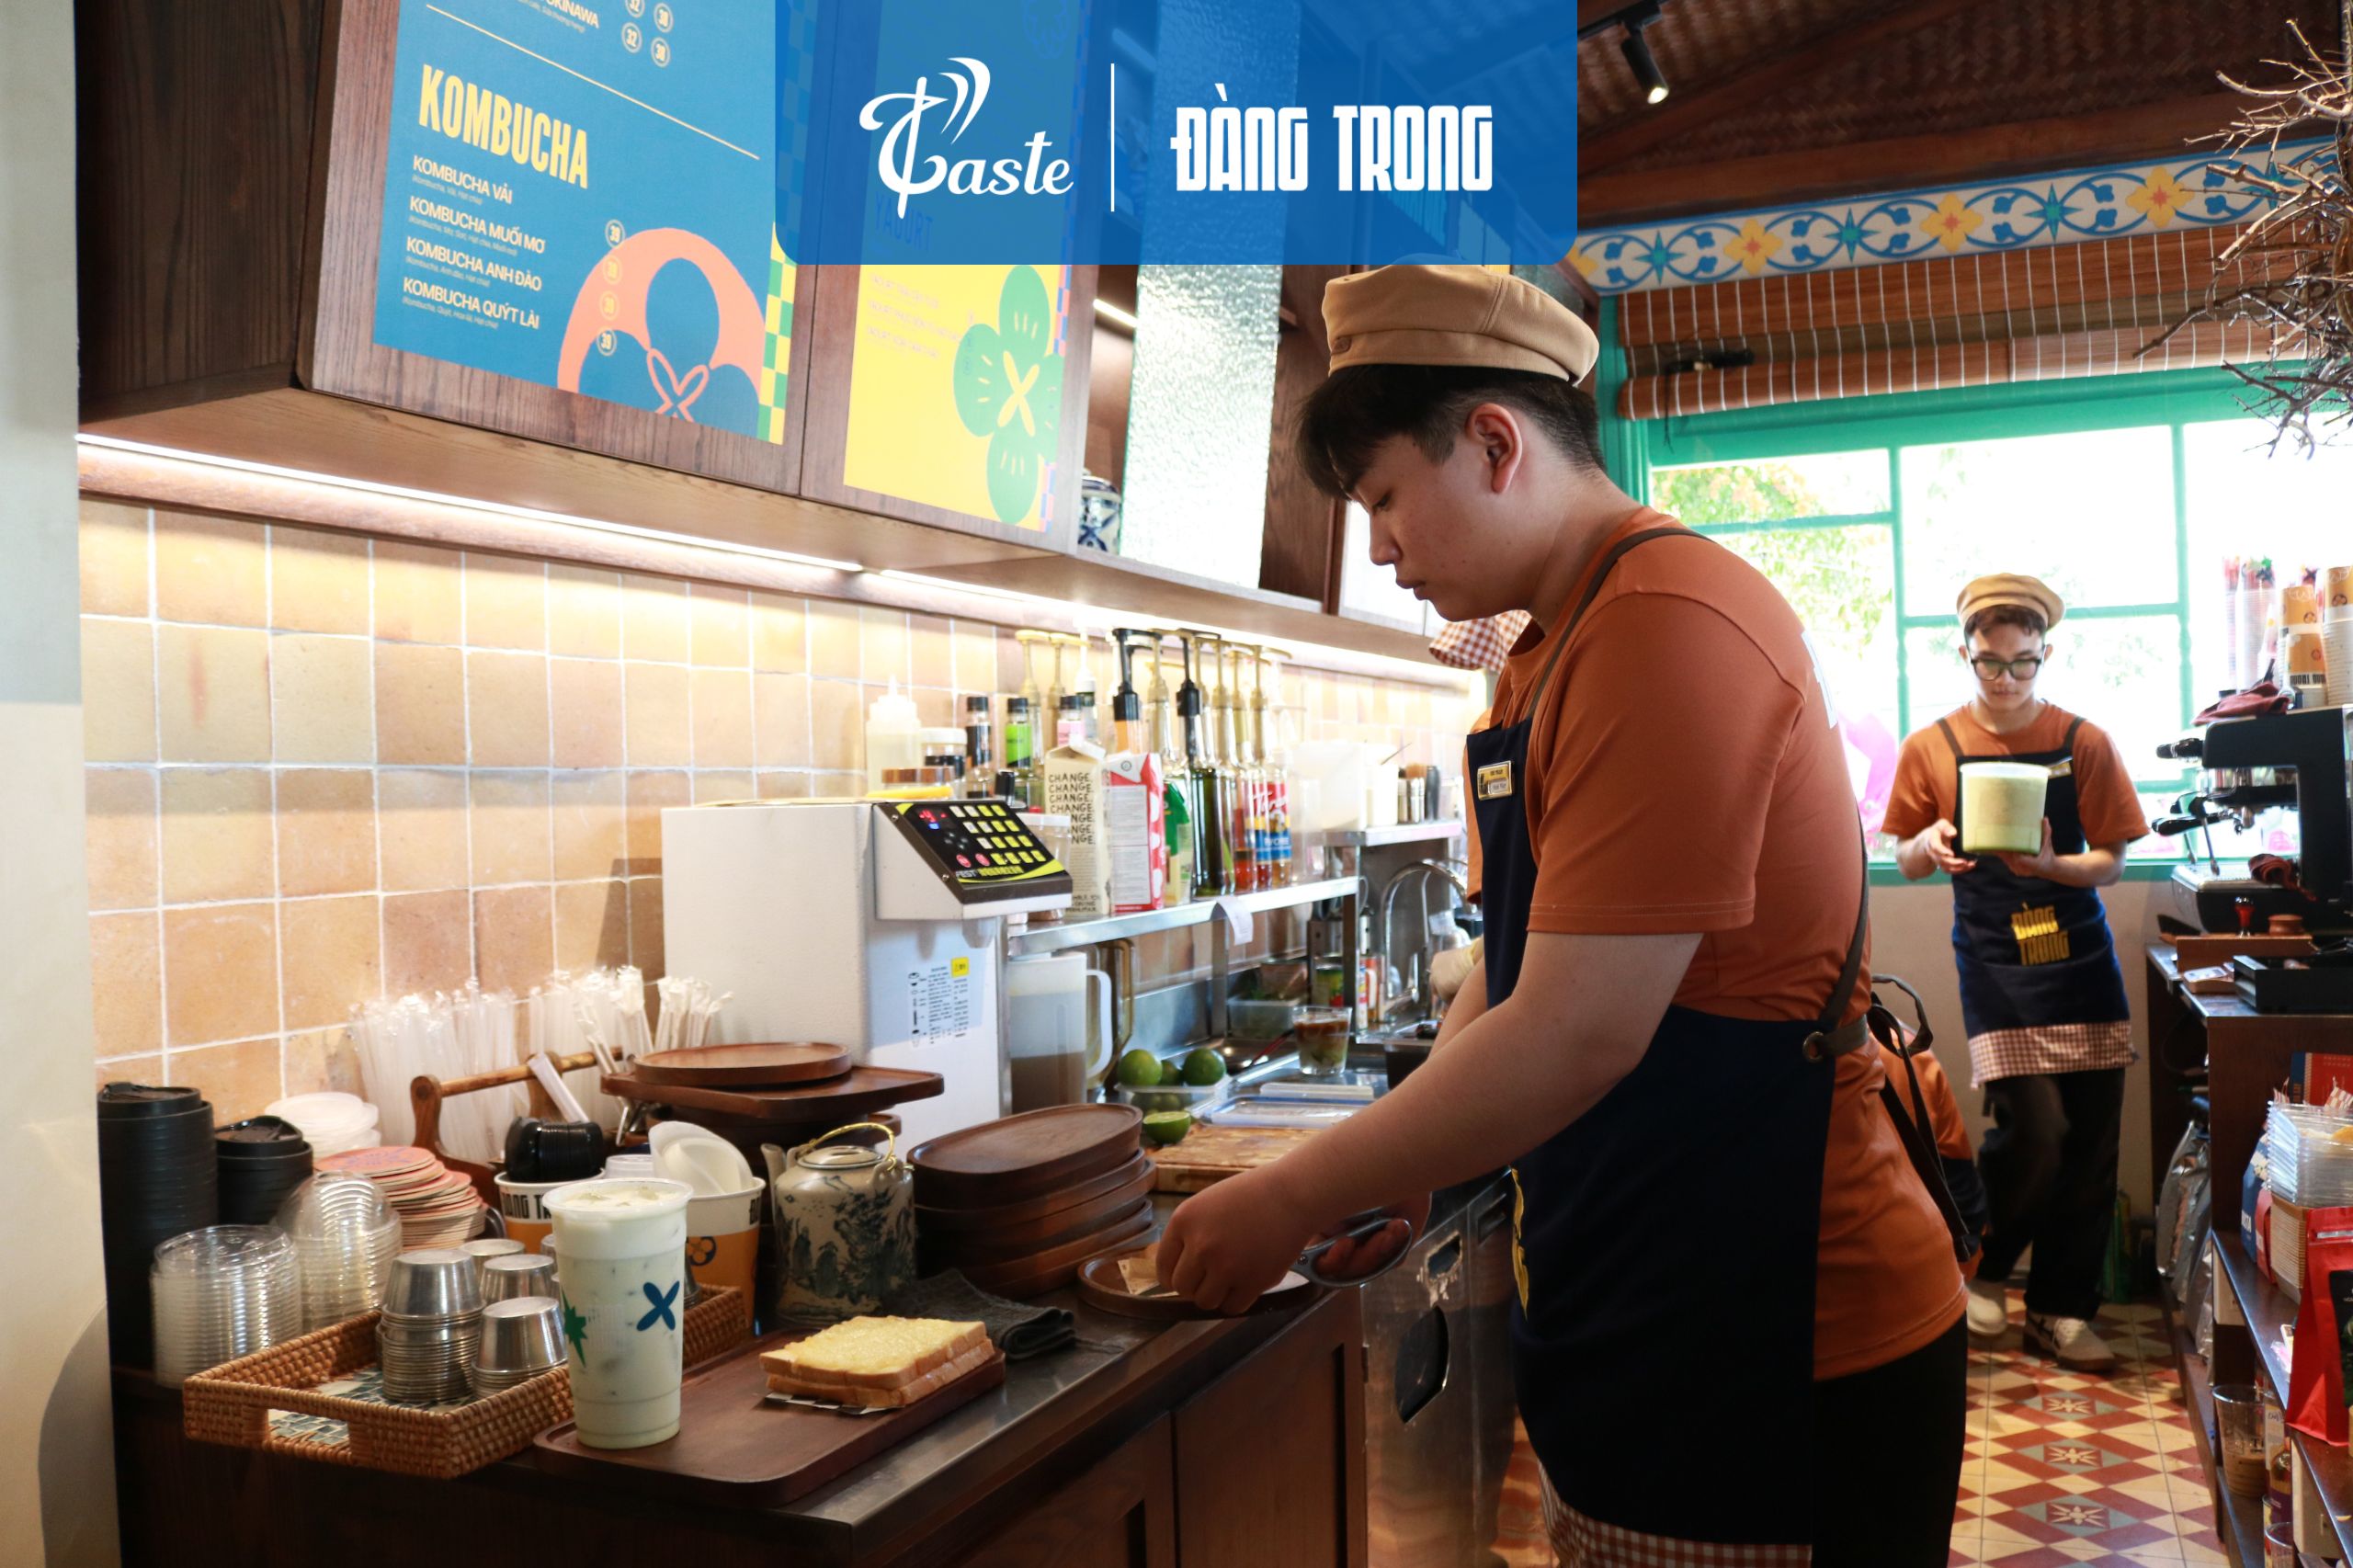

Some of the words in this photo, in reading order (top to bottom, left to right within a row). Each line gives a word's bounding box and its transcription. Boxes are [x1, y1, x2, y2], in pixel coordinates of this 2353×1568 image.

[419, 64, 587, 188] KOMBUCHA
[414, 155, 490, 197] KOMBUCHA
[410, 196, 486, 235] KOMBUCHA
[489, 222, 522, 246] MUỐI
[524, 235, 545, 254] MƠ
[406, 236, 483, 274] KOMBUCHA
[485, 262, 513, 283] ANH
[515, 269, 542, 291] ĐÀO
[403, 277, 481, 312] KOMBUCHA
[483, 300, 518, 323] QUÝT
[1071, 813, 1095, 824] NGE.
[1071, 835, 1096, 845] NGE.
[2018, 930, 2071, 966] TRONG
